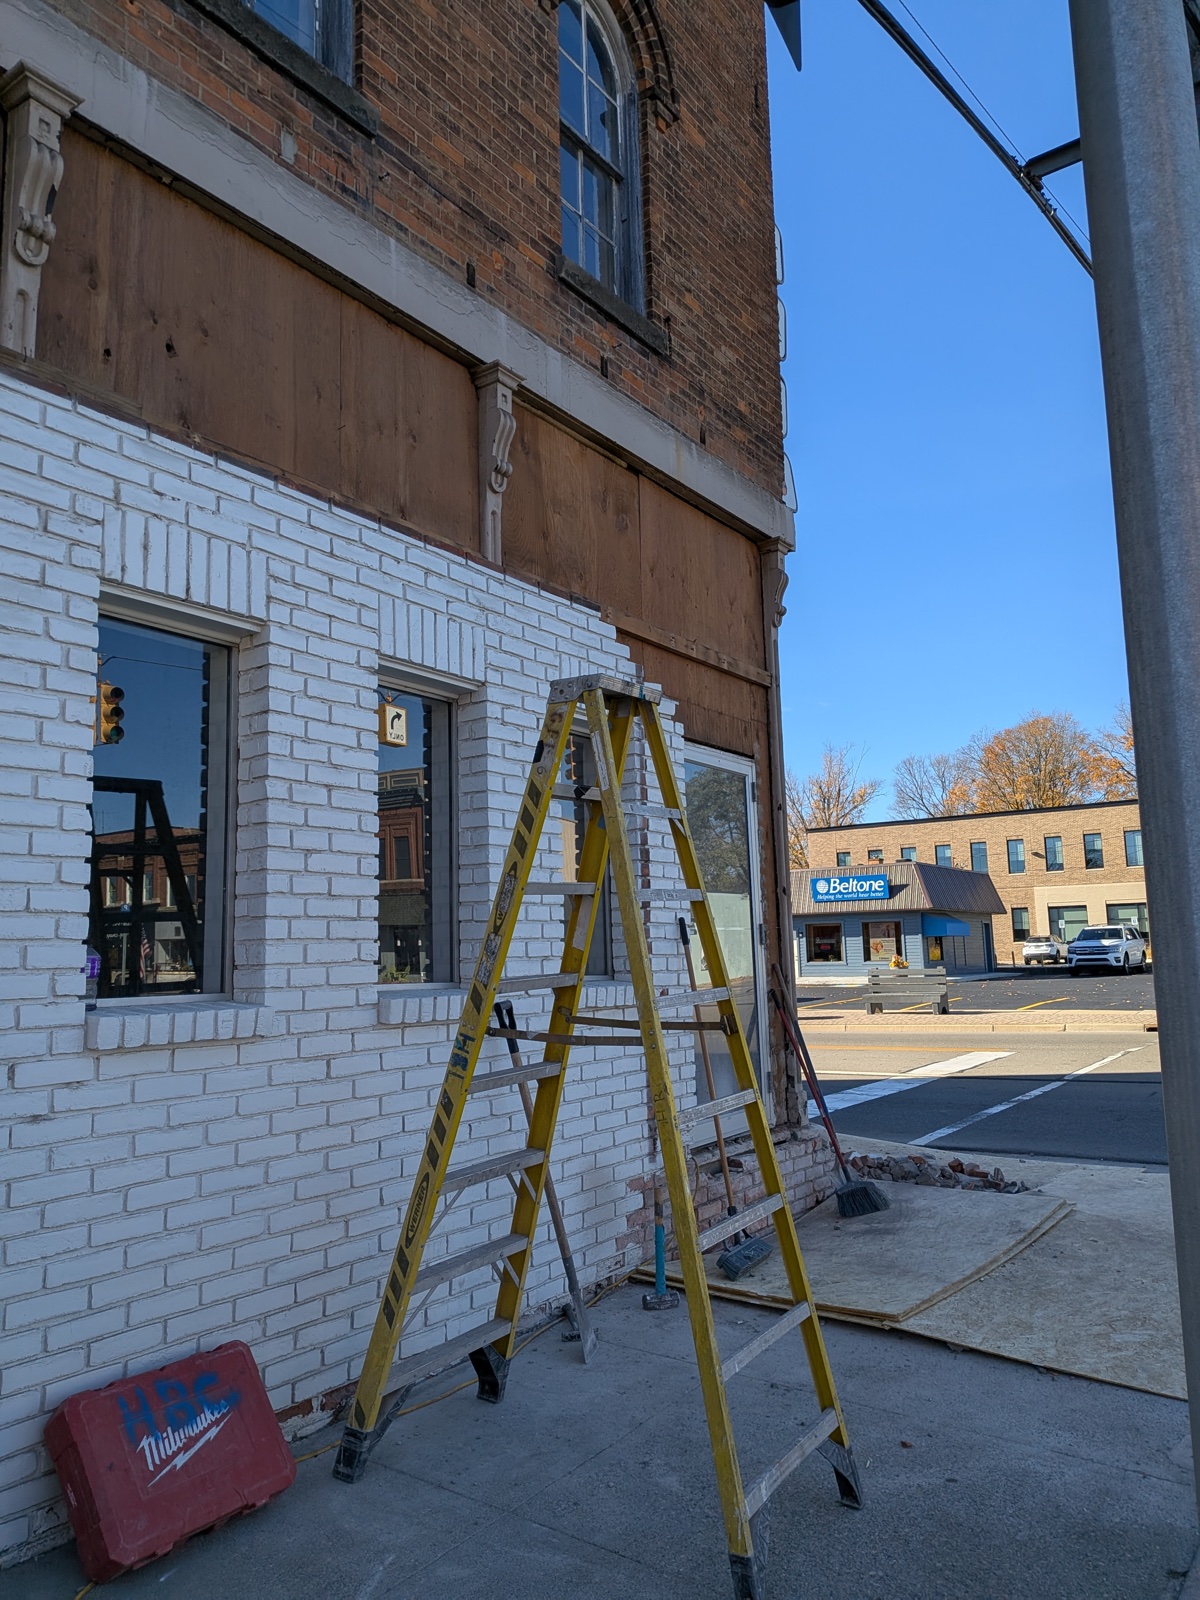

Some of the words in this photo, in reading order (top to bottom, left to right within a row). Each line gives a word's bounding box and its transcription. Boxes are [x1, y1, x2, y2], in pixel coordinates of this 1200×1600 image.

[829, 878, 884, 894] Beltone
[409, 1186, 426, 1233] WERNER
[118, 1371, 242, 1447] HBC
